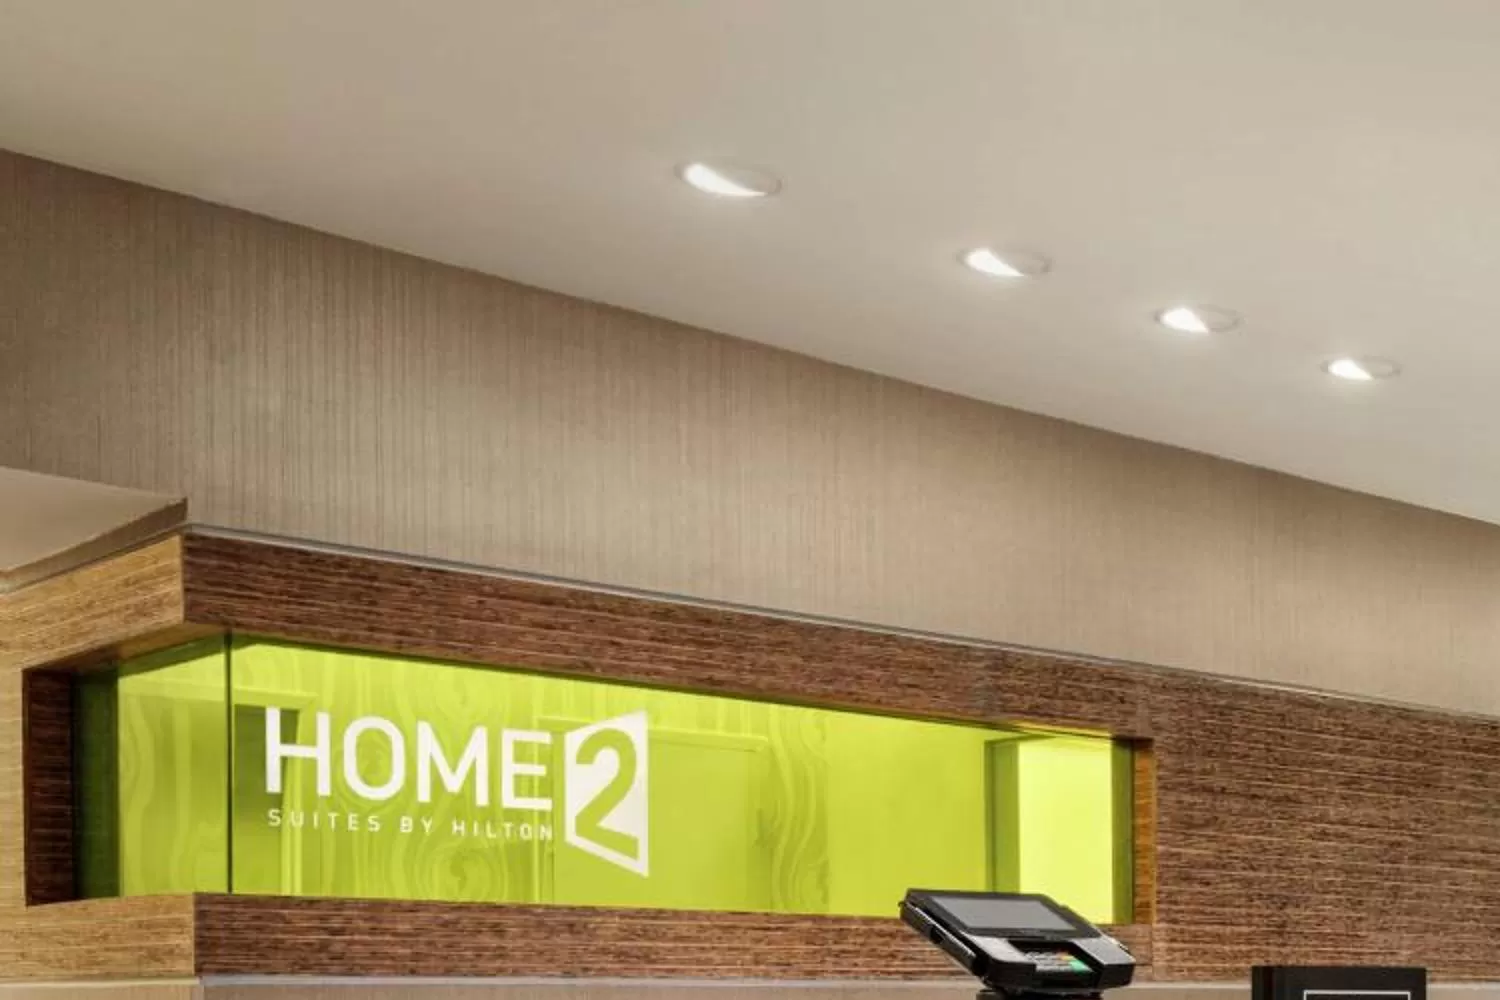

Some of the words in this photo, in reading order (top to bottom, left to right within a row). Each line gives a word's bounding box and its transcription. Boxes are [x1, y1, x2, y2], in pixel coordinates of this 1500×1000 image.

[267, 808, 380, 833] SUITES
[400, 816, 434, 834] BY
[451, 819, 553, 841] HILTON
